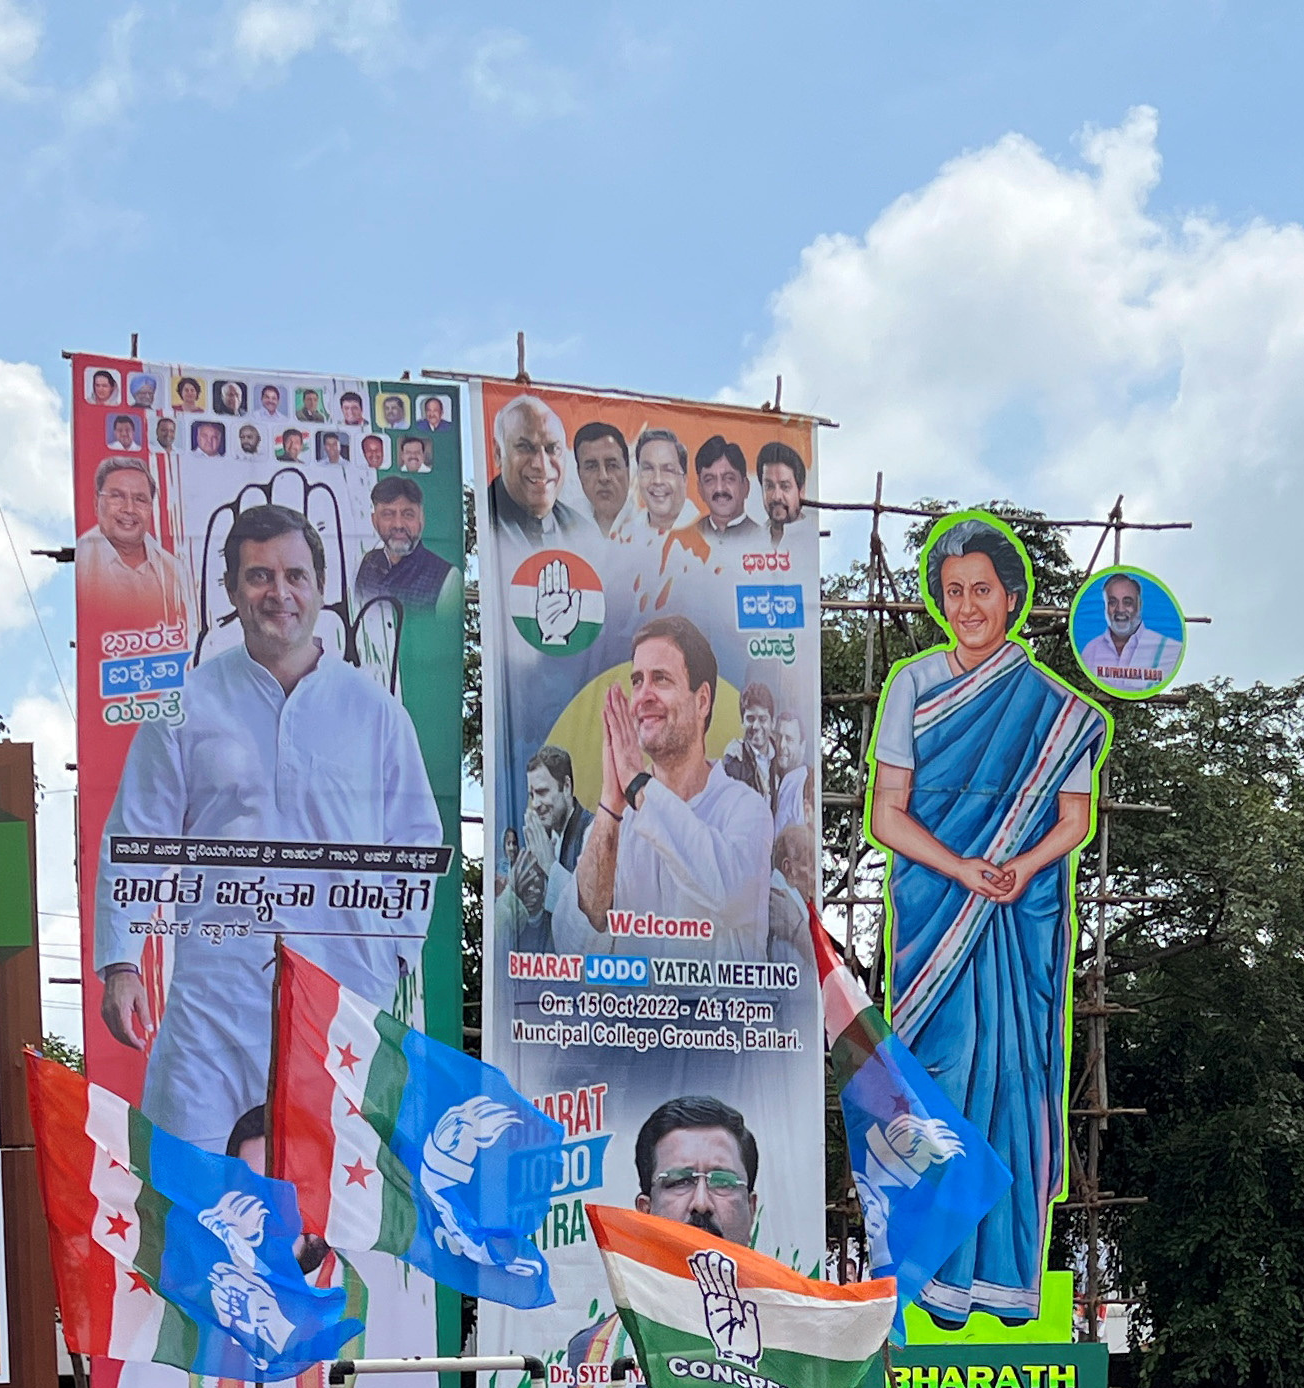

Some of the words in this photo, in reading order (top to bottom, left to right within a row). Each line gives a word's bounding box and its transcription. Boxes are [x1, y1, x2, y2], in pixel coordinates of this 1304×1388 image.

[742, 549, 791, 575] ಭಾರತ
[742, 593, 796, 629] ಐಕ್ಯತಾ
[102, 622, 185, 655] ಭಾರತ
[748, 633, 797, 666] ಯಾತ್ರೆ
[108, 657, 179, 692] ಐಕ್ಯತಾ
[104, 690, 186, 726] ಯಾತ್ರೆ
[113, 873, 204, 908] ಭಾರತ
[216, 876, 315, 922] ಐಕ್ಯತಾ
[328, 878, 431, 919] ಯಾತ್ರೆಗೆ
[608, 910, 713, 939] Welcome
[509, 953, 583, 981] BHARAT
[587, 959, 647, 982] JODO
[652, 961, 714, 984] YATRA
[717, 964, 799, 988] MEETING
[539, 994, 572, 1015] On:
[577, 995, 599, 1016] 15
[601, 996, 634, 1018] Oct
[635, 997, 678, 1018] 2022
[696, 1000, 721, 1020] At:
[727, 1002, 773, 1026] 12pm
[594, 1025, 658, 1051] College
[660, 1027, 740, 1053] Grounds,
[744, 1029, 804, 1052] Ballari.
[550, 1366, 574, 1385] Dr.
[579, 1365, 612, 1384] SYE
